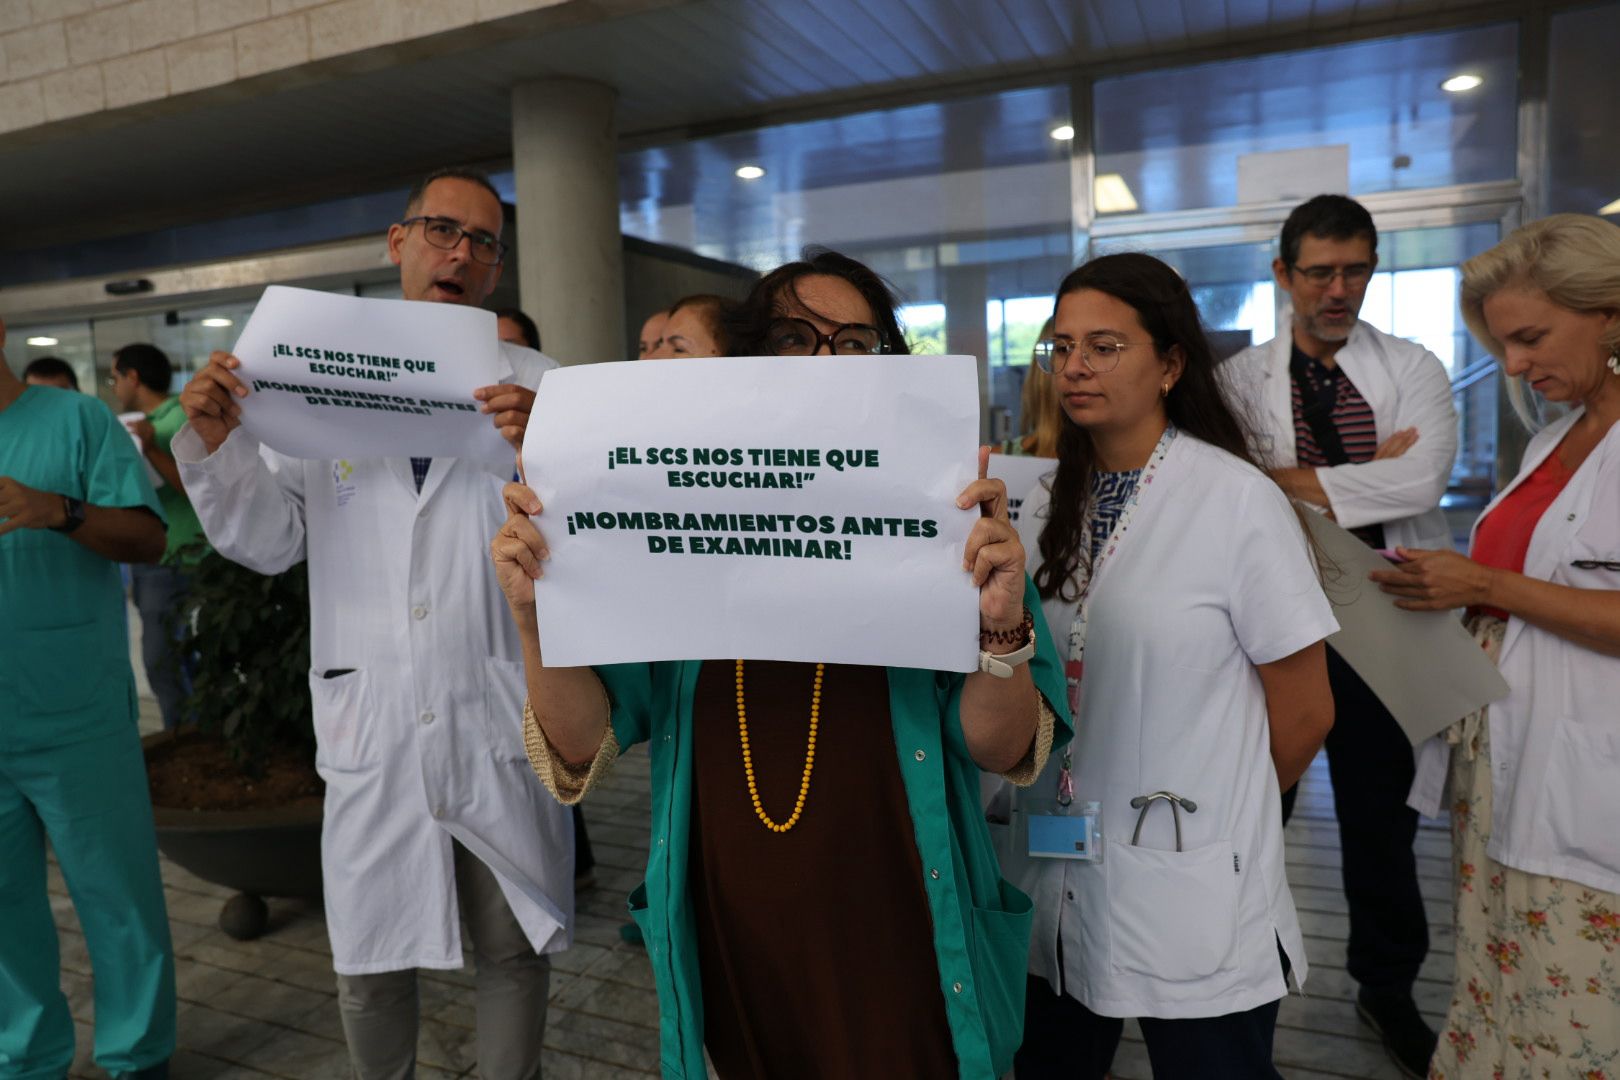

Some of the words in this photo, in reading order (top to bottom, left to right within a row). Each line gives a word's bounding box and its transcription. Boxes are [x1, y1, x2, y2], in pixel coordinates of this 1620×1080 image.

[273, 344, 294, 358] ¡EL
[296, 347, 322, 360] SCS
[324, 350, 355, 364] NOS
[357, 354, 402, 370] TIENE
[404, 359, 436, 374] QUE
[253, 379, 417, 407] ¡NOMBRAMIENTOS
[420, 399, 478, 413] ANTES
[305, 395, 331, 406] DE
[332, 398, 433, 416] EXAMINAR!
[608, 447, 642, 470] ¡EL
[646, 447, 688, 465] SCS
[692, 448, 744, 466] NOS
[748, 449, 821, 468] TIENE
[825, 449, 879, 472] QUE
[566, 511, 836, 535] ¡NOMBRAMIENTOS
[841, 516, 938, 539] ANTES
[647, 535, 685, 555] DE
[688, 536, 852, 561] EXAMINAR!
